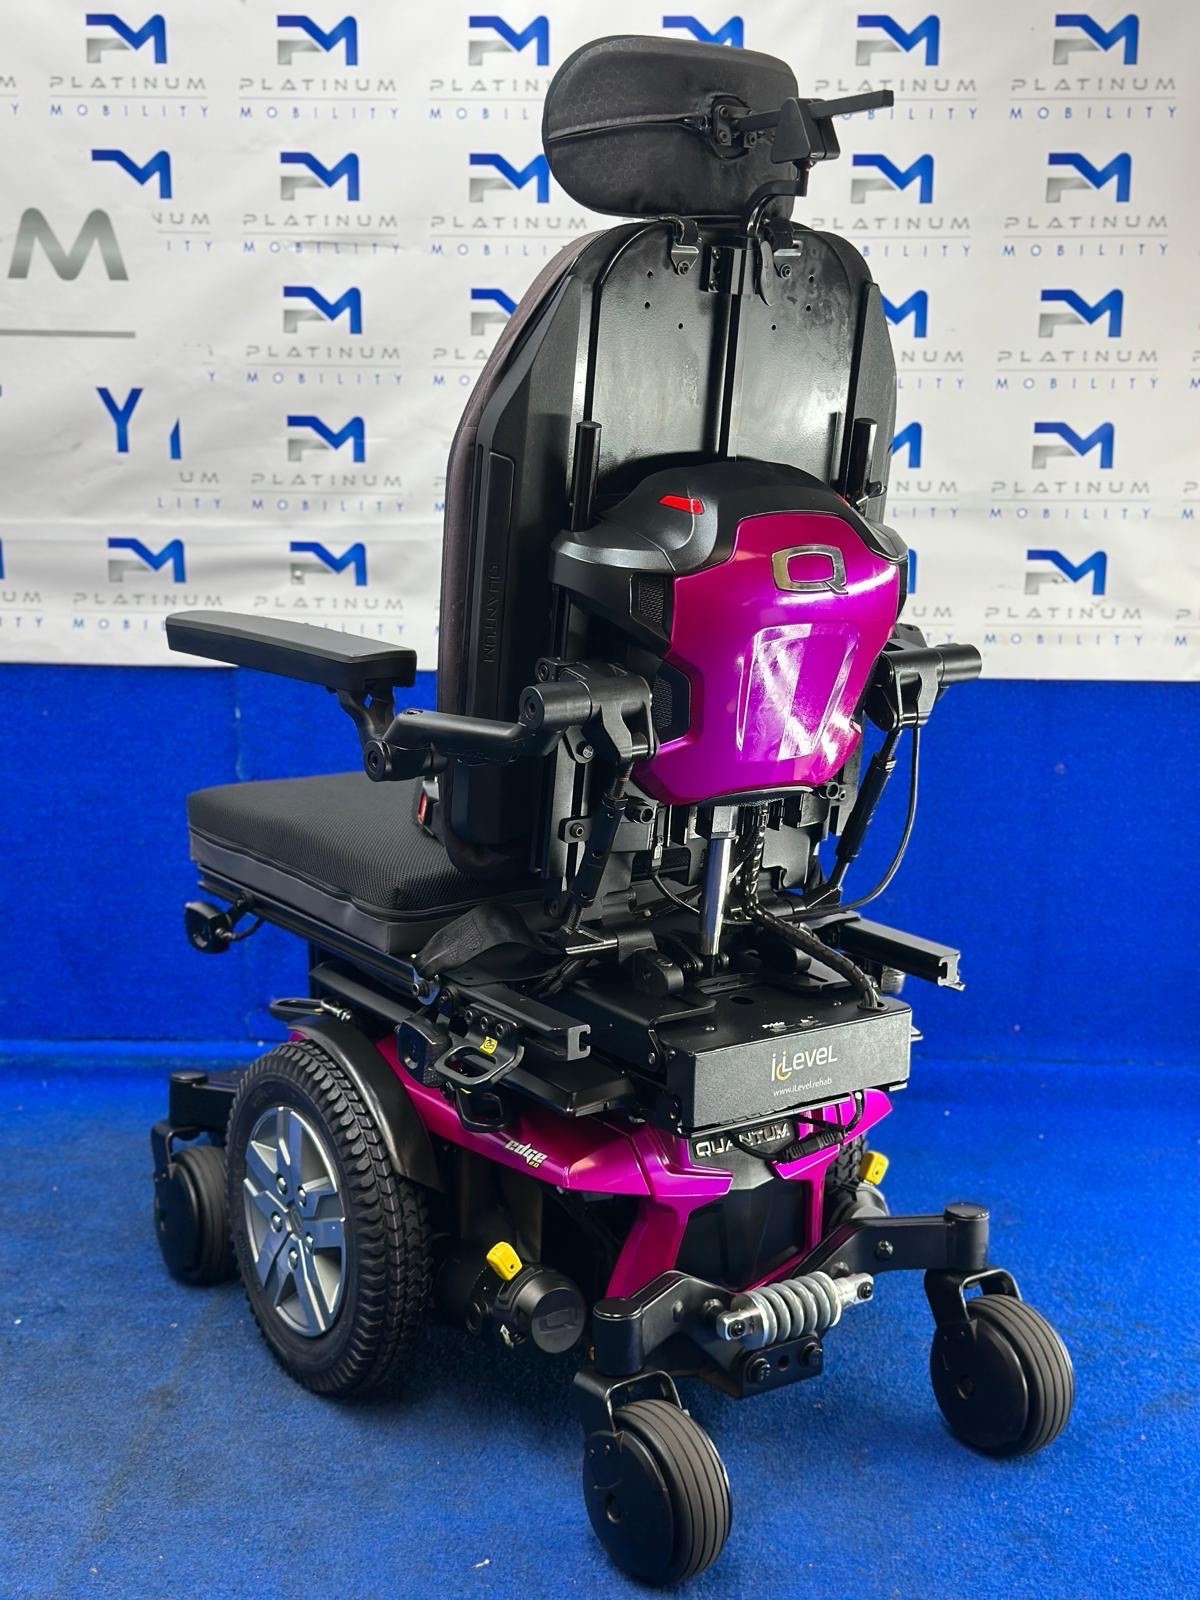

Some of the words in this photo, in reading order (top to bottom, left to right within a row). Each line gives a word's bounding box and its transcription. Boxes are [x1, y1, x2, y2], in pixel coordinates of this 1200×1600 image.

[49, 76, 206, 89] PLATINUM
[239, 78, 396, 91] PLATINUM
[815, 79, 977, 92] PLATINUM
[1011, 78, 1176, 91] PLATINUM
[50, 104, 208, 117] MOBILITY
[240, 106, 397, 119] MOBILITY
[1010, 106, 1176, 119] MOBILITY
[243, 213, 397, 227] PLATINUM
[430, 215, 587, 229] PLATINUM
[811, 217, 970, 230] PLATINUM
[1004, 216, 1168, 229] PLATINUM
[244, 240, 400, 254] MOBILITY
[1003, 243, 1168, 256] MOBILITY
[246, 346, 400, 359] PLATINUM
[997, 350, 1158, 362] PLATINUM
[246, 372, 401, 384] MOBILITY
[996, 378, 1158, 389] MOBILITY
[250, 473, 401, 486] PLATINUM
[991, 481, 1149, 494] PLATINUM
[251, 498, 403, 511] MOBILITY
[990, 507, 1149, 519] MOBILITY
[772, 543, 848, 596] Q
[73, 591, 222, 606] PLATINUM
[254, 597, 404, 610] PLATINUM
[985, 607, 1142, 620] PLATINUM
[984, 633, 1142, 645] MOBILITY
[504, 1140, 549, 1164] edge
